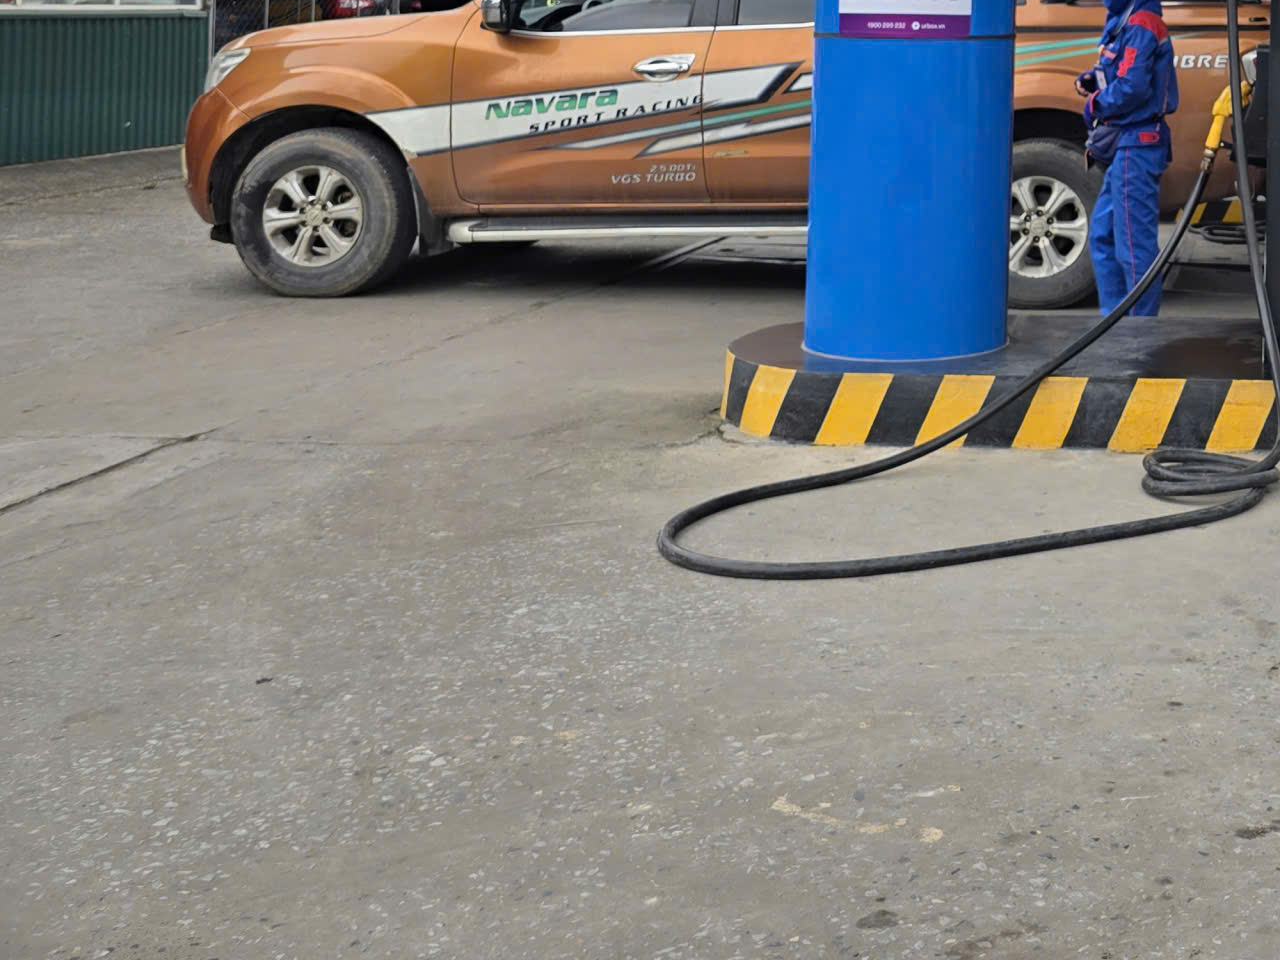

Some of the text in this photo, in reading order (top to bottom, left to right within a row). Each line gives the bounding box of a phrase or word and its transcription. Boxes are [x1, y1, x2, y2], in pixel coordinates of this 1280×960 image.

[484, 89, 619, 121] Navara
[529, 95, 704, 134] SPORT RACING
[646, 171, 696, 183] TURBO
